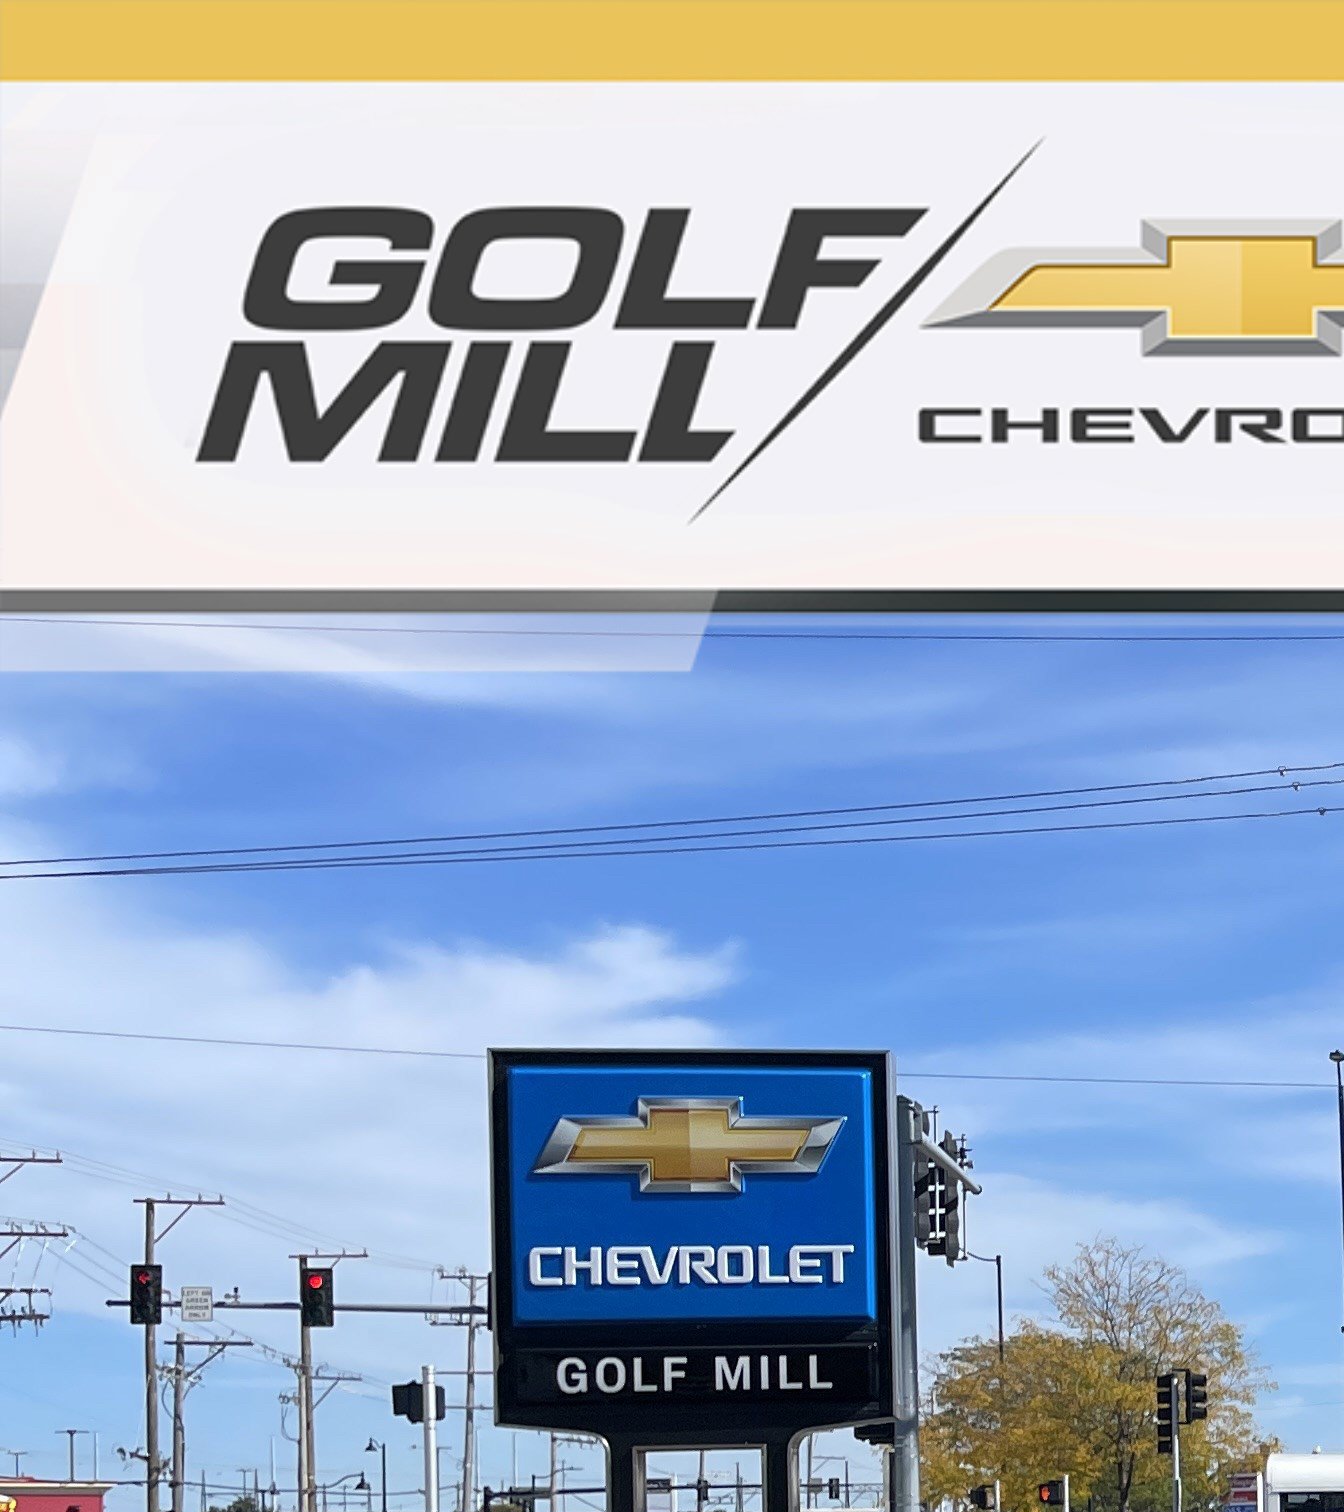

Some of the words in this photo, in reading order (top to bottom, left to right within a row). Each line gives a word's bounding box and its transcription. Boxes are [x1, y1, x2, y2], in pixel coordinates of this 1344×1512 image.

[528, 1244, 855, 1286] CHEVROLET
[556, 1356, 688, 1393] GOLF
[714, 1355, 834, 1391] MILL
